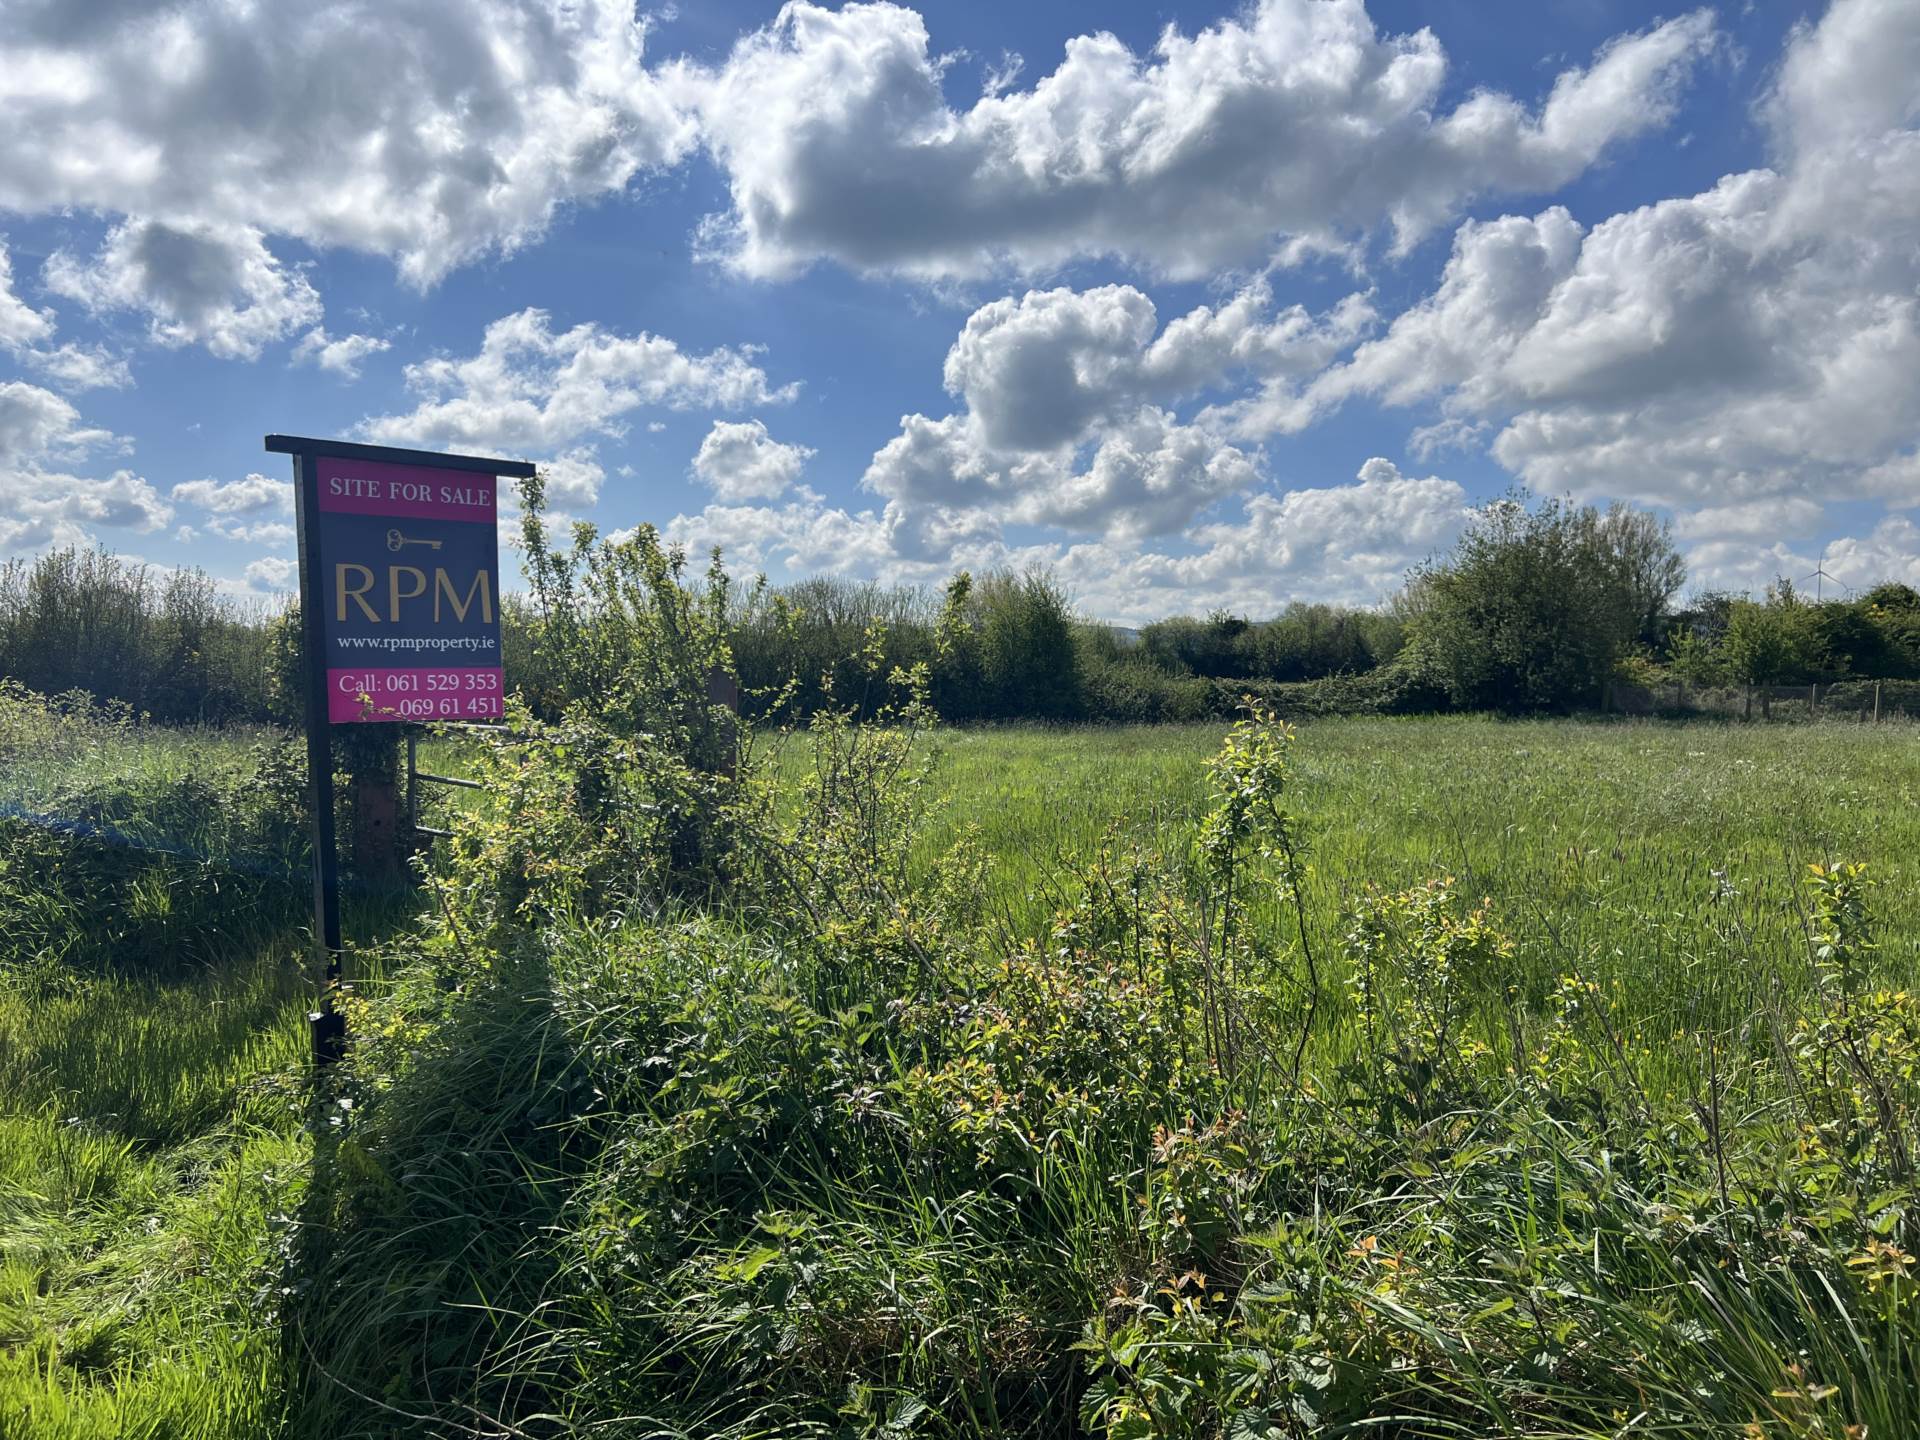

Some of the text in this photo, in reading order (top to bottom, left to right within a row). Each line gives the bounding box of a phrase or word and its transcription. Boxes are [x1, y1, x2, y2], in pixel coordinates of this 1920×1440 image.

[330, 477, 491, 506] SITE FOR SALE
[335, 563, 493, 623] RPM
[337, 635, 495, 652] www.rpmproperty.ie
[339, 673, 497, 693] Call: 061 529 353
[400, 697, 498, 716] 069 61 451
